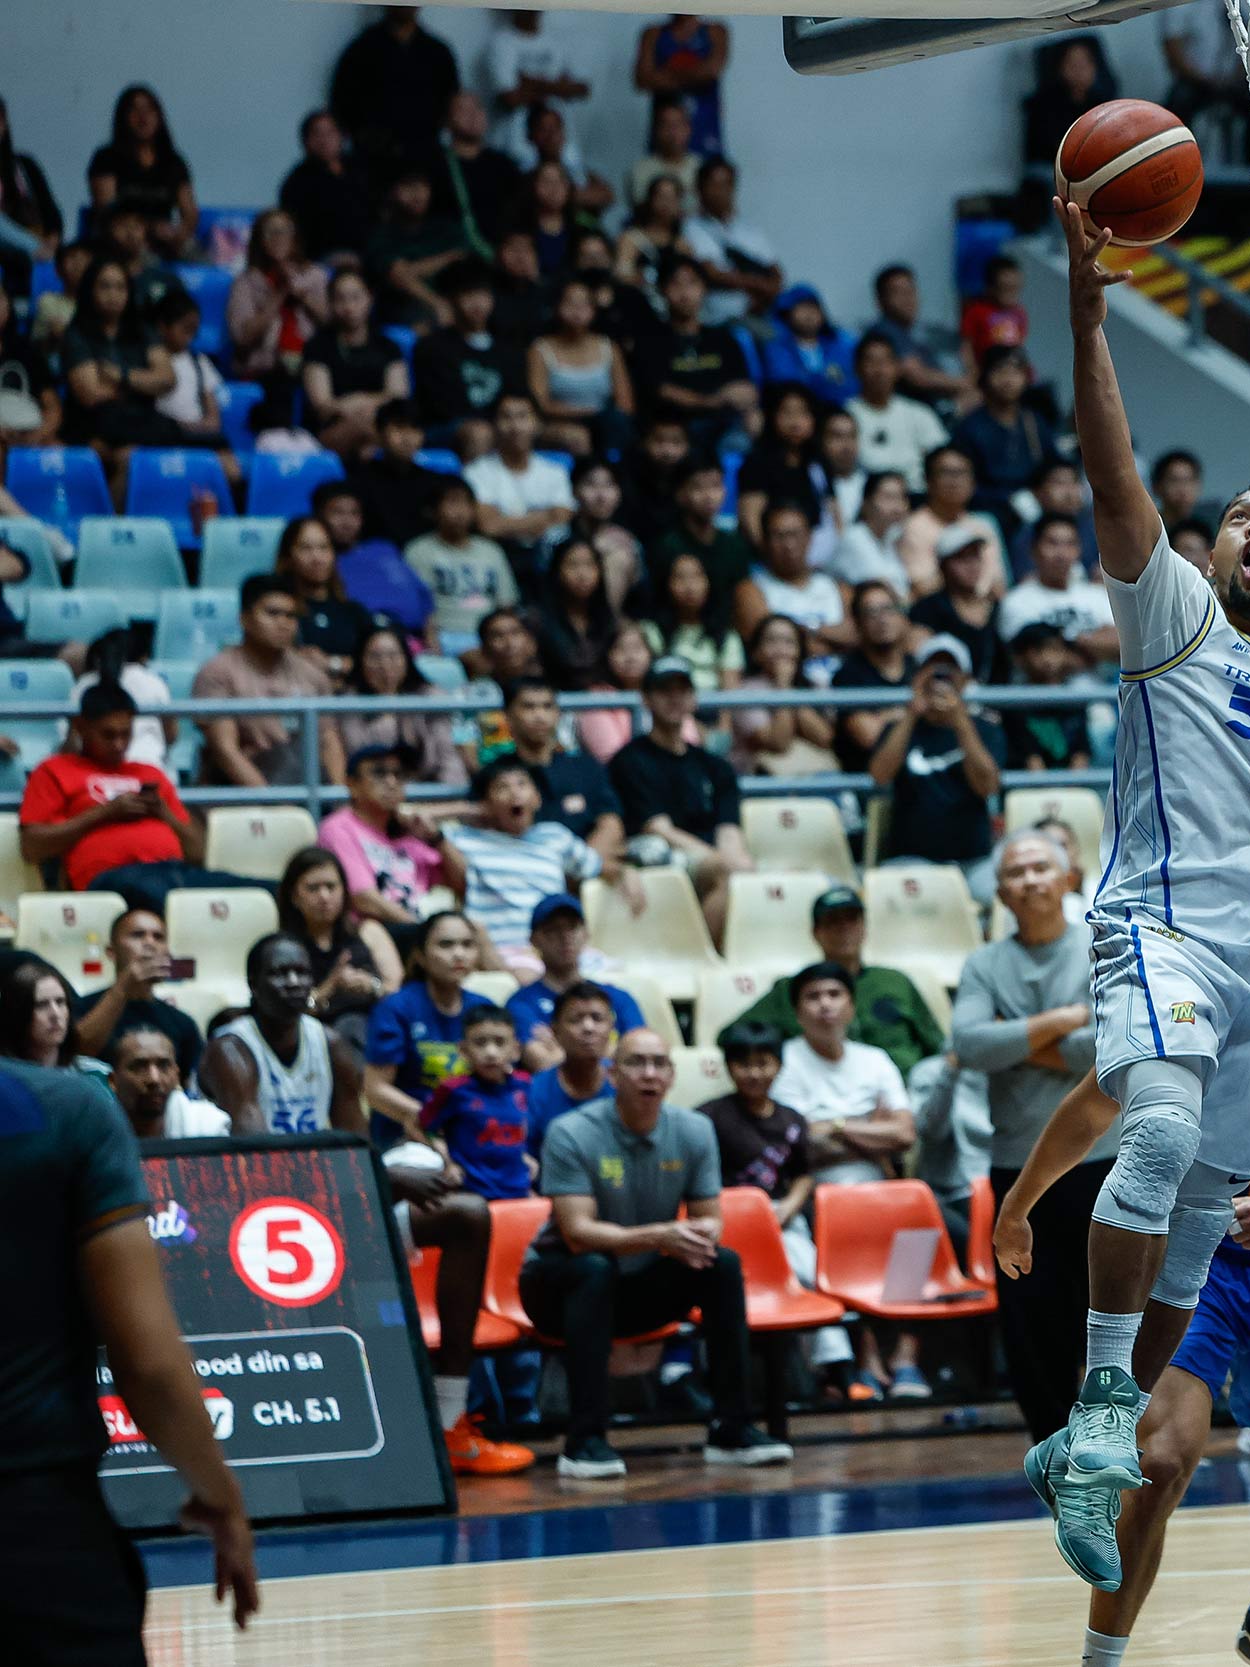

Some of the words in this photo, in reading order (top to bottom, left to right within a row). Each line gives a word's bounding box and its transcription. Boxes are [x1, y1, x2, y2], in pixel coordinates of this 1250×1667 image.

[266, 1219, 314, 1285] 5
[247, 1350, 290, 1375] din
[294, 1351, 324, 1373] sa
[253, 1400, 302, 1426] CH.
[305, 1397, 341, 1423] 5.1
